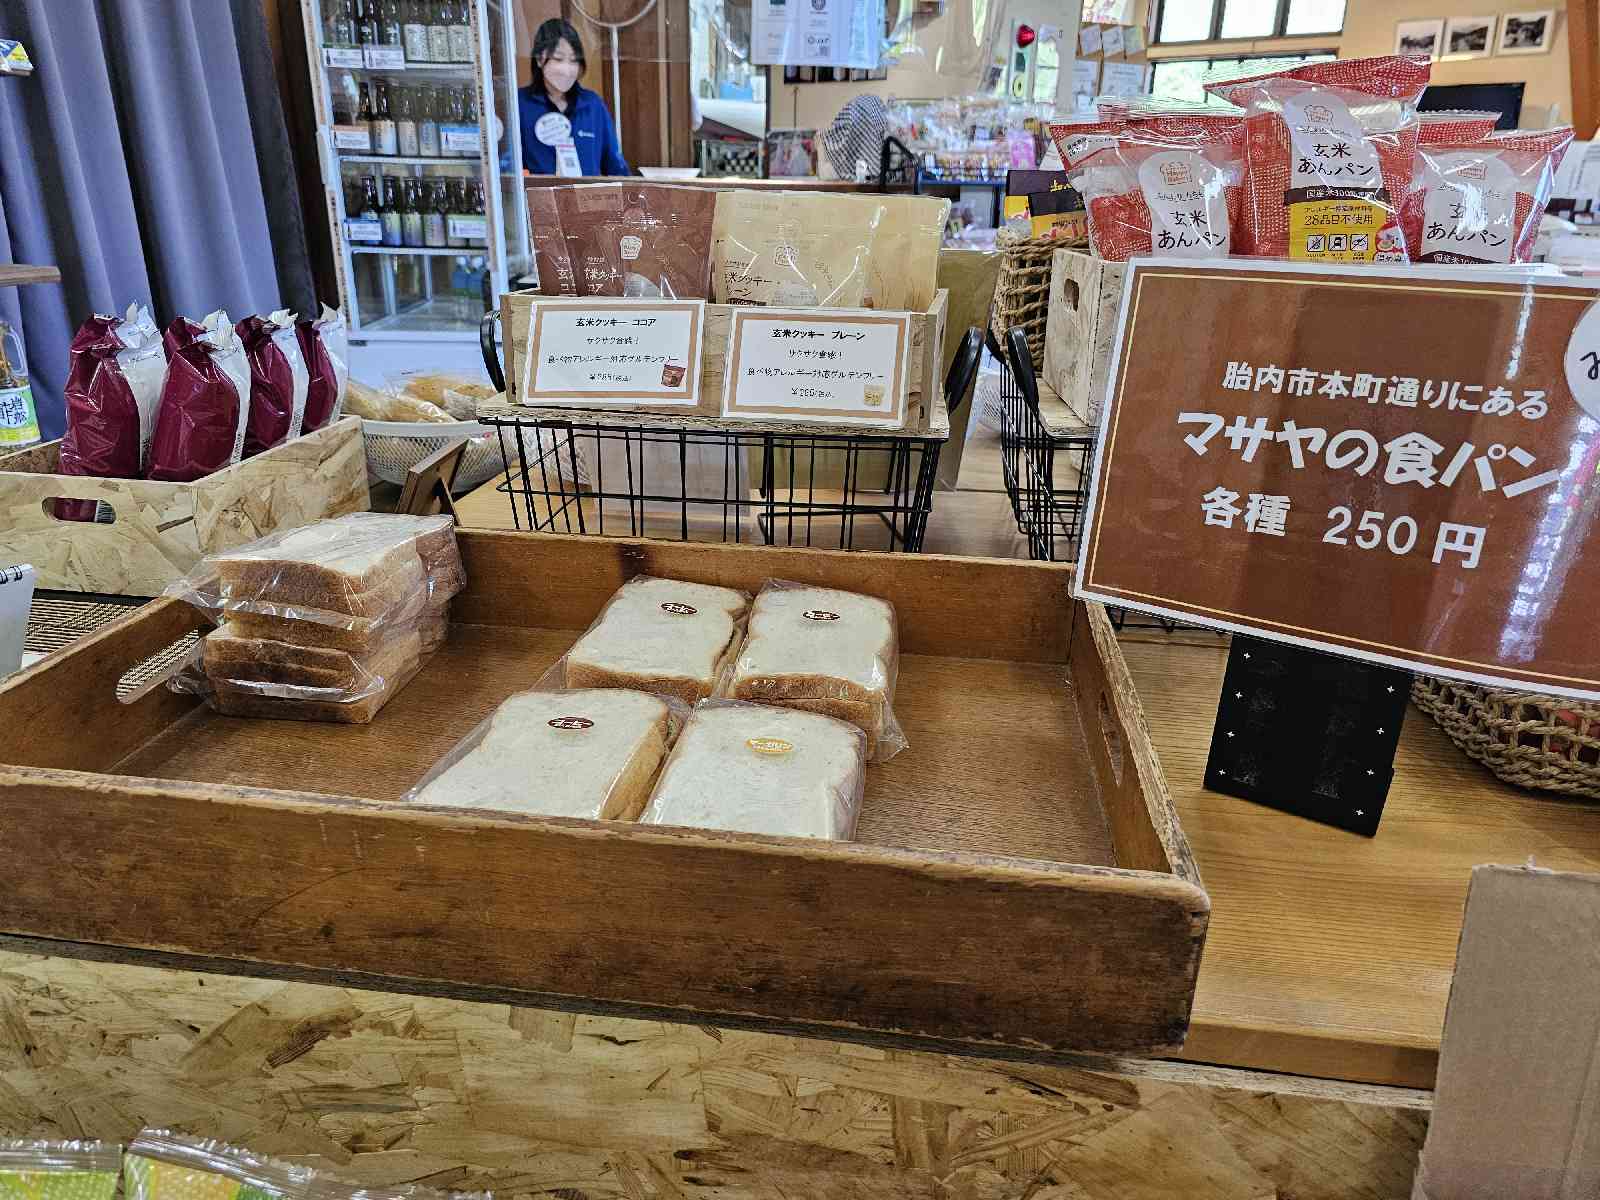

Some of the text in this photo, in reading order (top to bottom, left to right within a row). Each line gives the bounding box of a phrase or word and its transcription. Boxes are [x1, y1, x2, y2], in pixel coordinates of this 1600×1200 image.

[1313, 142, 1352, 159] 玄米
[1298, 158, 1374, 176] あんパン
[1170, 210, 1208, 227] 玄米
[1158, 229, 1226, 250] あんパン
[1427, 221, 1507, 247] あんパン
[576, 318, 657, 327] 玄米クッキー ココア
[772, 329, 866, 340] 玄米クッキー プレーン
[1222, 361, 1549, 420] 胎内市本町通りにある
[1177, 411, 1560, 498] マサヤの食パン
[1200, 487, 1291, 538] 各種
